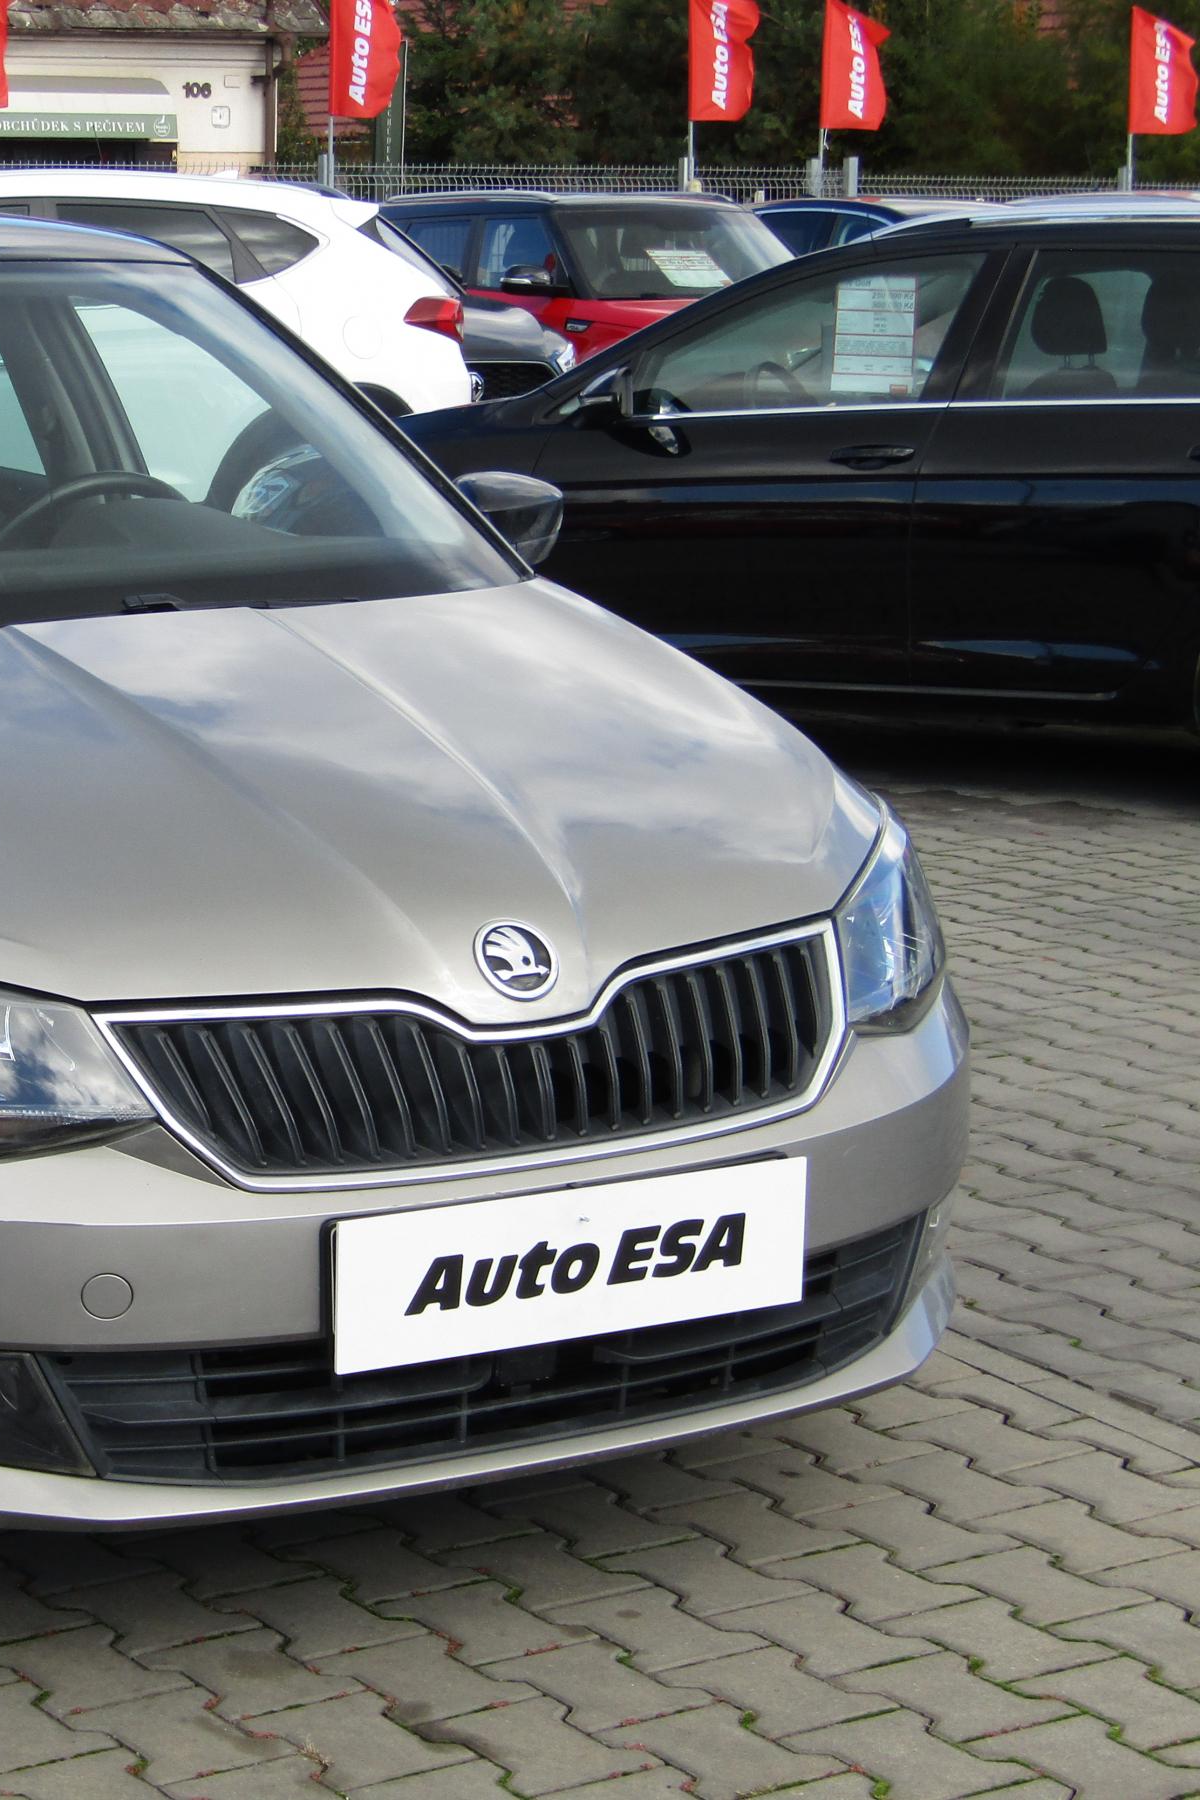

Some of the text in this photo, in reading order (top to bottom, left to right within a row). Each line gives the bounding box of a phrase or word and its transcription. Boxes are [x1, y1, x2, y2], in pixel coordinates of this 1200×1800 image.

[348, 0, 373, 107] Auto ES
[709, 1, 729, 111] Auto ESA
[182, 81, 212, 99] 106
[848, 57, 866, 120] Auto
[1153, 63, 1169, 125] Auto
[73, 119, 82, 132] S
[86, 117, 145, 133] PEČIVEM
[403, 1212, 747, 1317] Auto ESA
